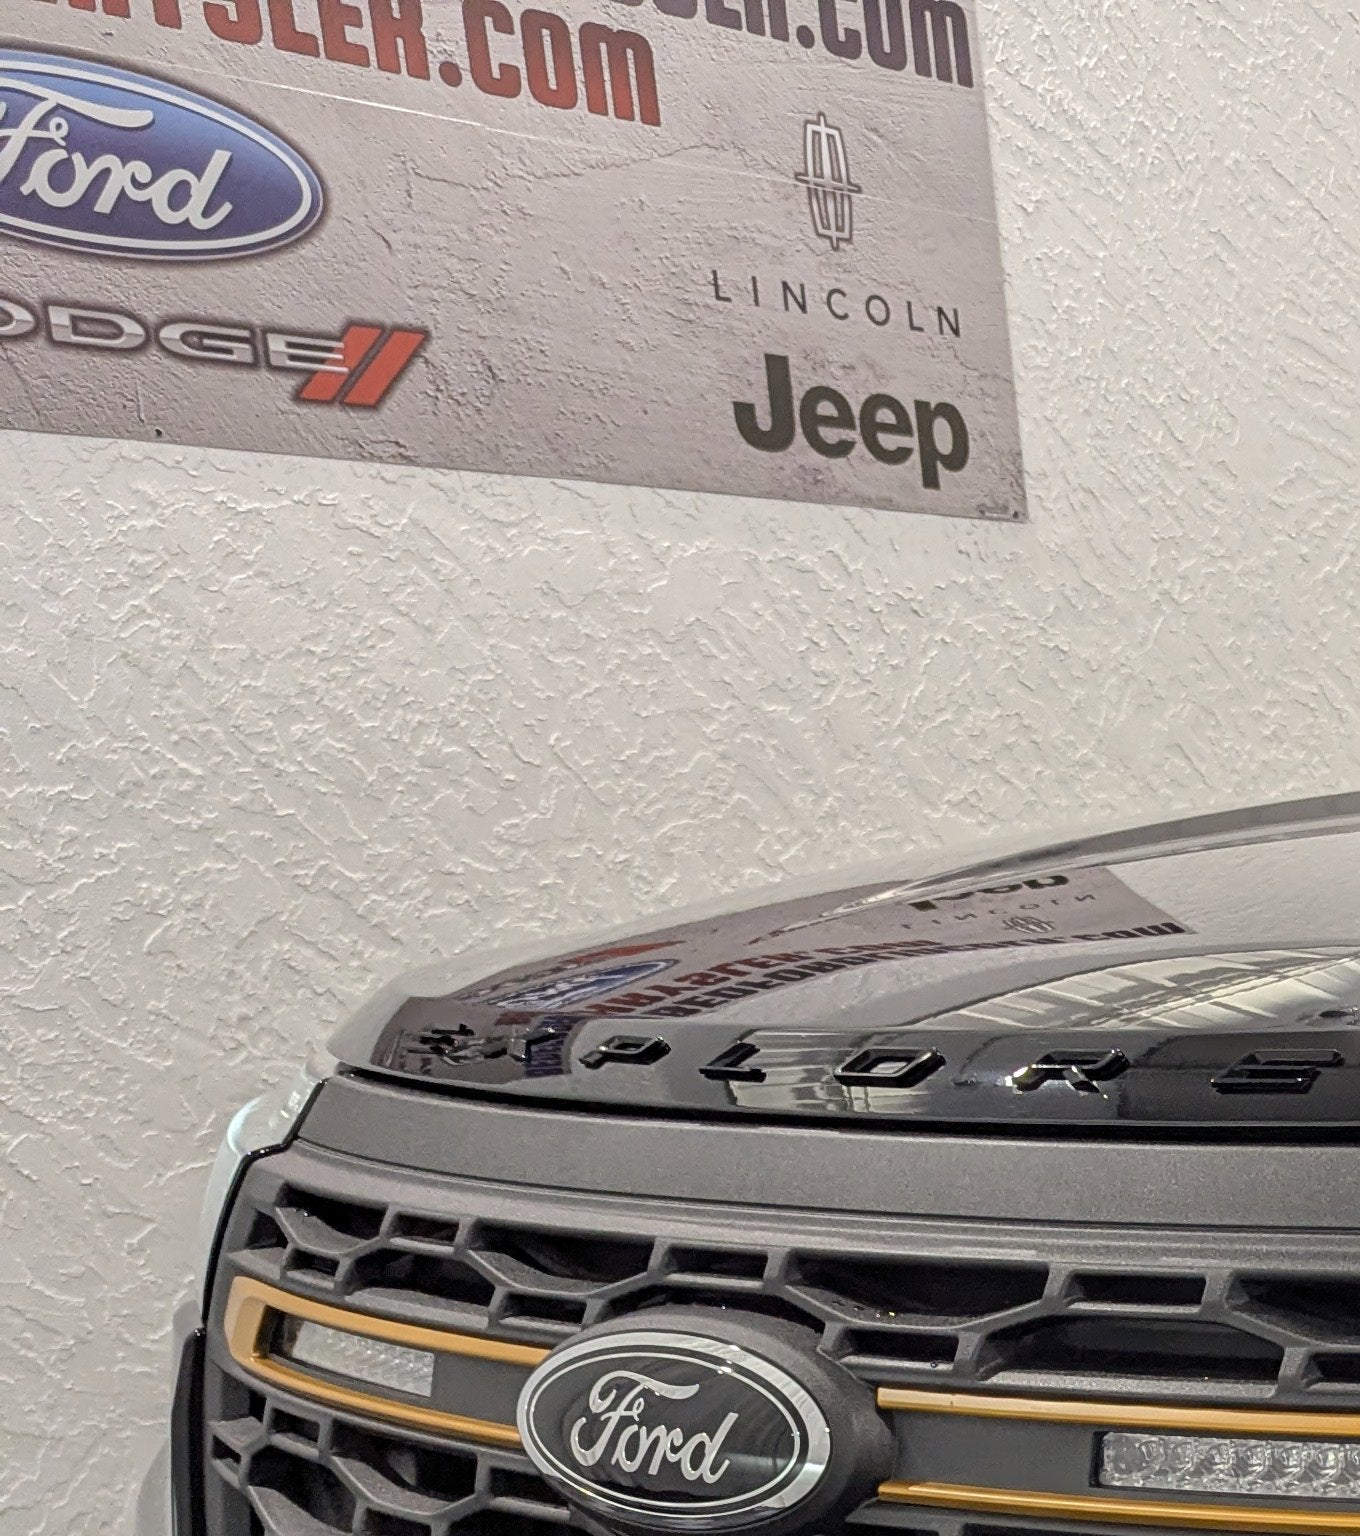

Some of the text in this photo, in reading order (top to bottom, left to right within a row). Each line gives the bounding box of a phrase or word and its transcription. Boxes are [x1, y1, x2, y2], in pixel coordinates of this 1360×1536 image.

[711, 269, 961, 338] LINCOLN
[732, 353, 970, 491] Jeep
[570, 1370, 740, 1484] Ford
